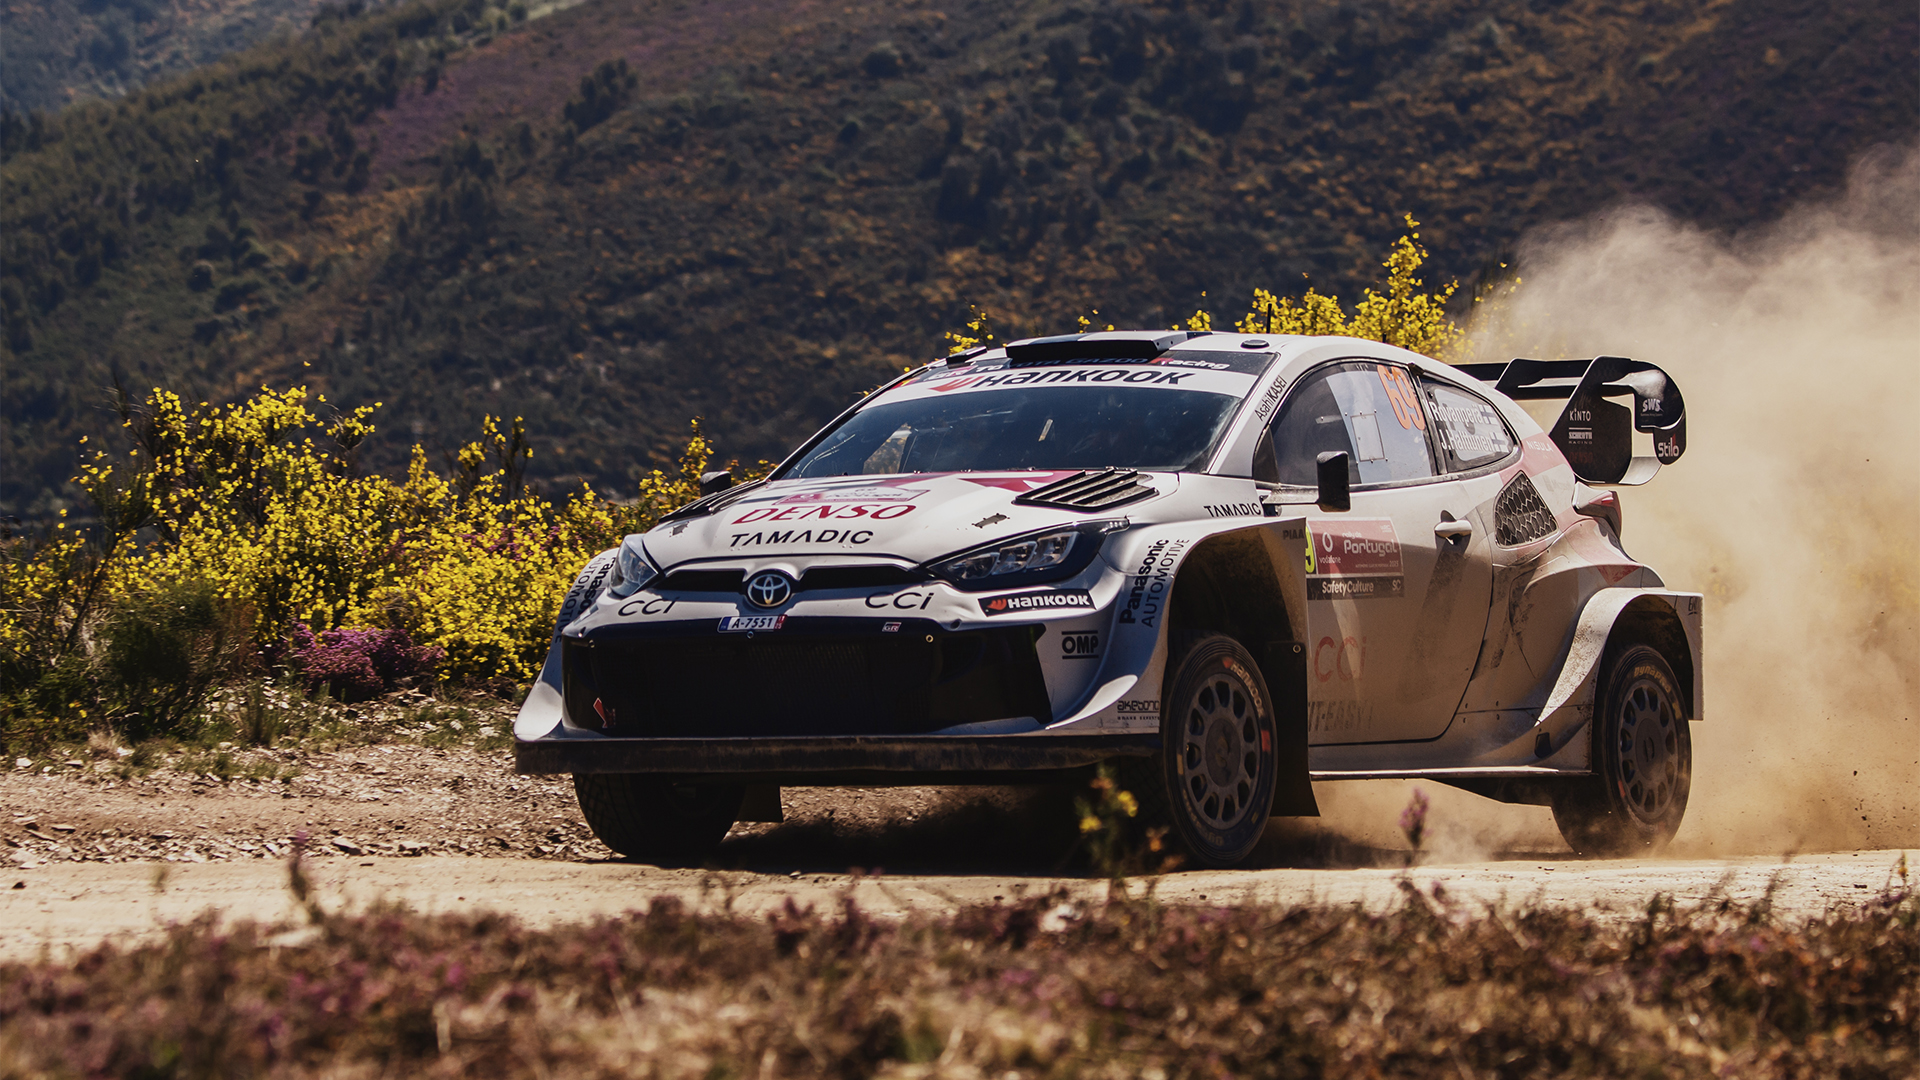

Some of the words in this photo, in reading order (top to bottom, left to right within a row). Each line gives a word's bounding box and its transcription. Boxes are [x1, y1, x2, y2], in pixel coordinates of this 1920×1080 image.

[1377, 364, 1426, 431] 69
[1526, 440, 1554, 452] NISULA
[1657, 436, 1680, 458] Stilo
[731, 504, 916, 525] DENSO
[1204, 502, 1262, 518] TAMADIC
[730, 530, 874, 548] TAMADIC
[1282, 528, 1305, 540] PIAA
[1343, 539, 1398, 557] Portugal
[1119, 539, 1169, 625] Panasonic
[1141, 539, 1190, 628] AUTOMOTIVE
[1322, 581, 1374, 597] SafetyCulture
[731, 617, 773, 629] A-7551
[1061, 635, 1099, 654] OMP
